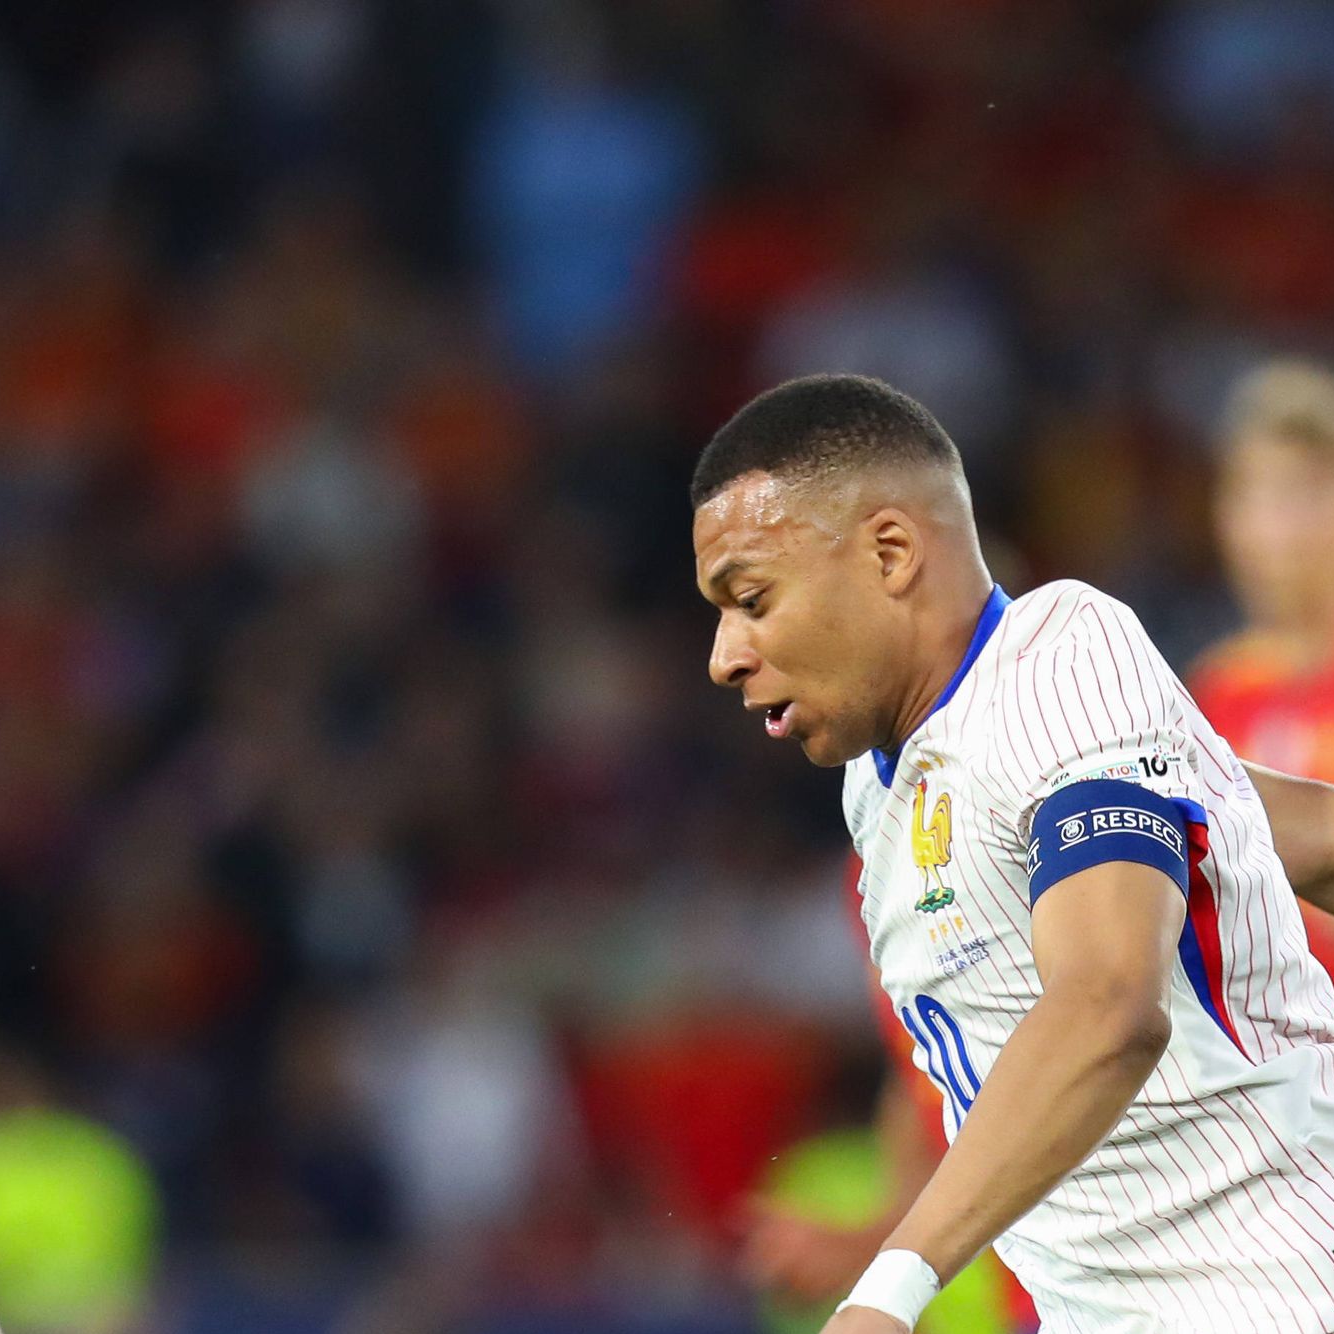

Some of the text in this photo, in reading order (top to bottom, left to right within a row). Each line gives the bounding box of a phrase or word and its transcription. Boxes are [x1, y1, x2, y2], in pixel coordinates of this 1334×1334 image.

[1139, 756, 1168, 777] 10
[1051, 772, 1070, 787] UEFA
[1093, 812, 1183, 852] RESPECT
